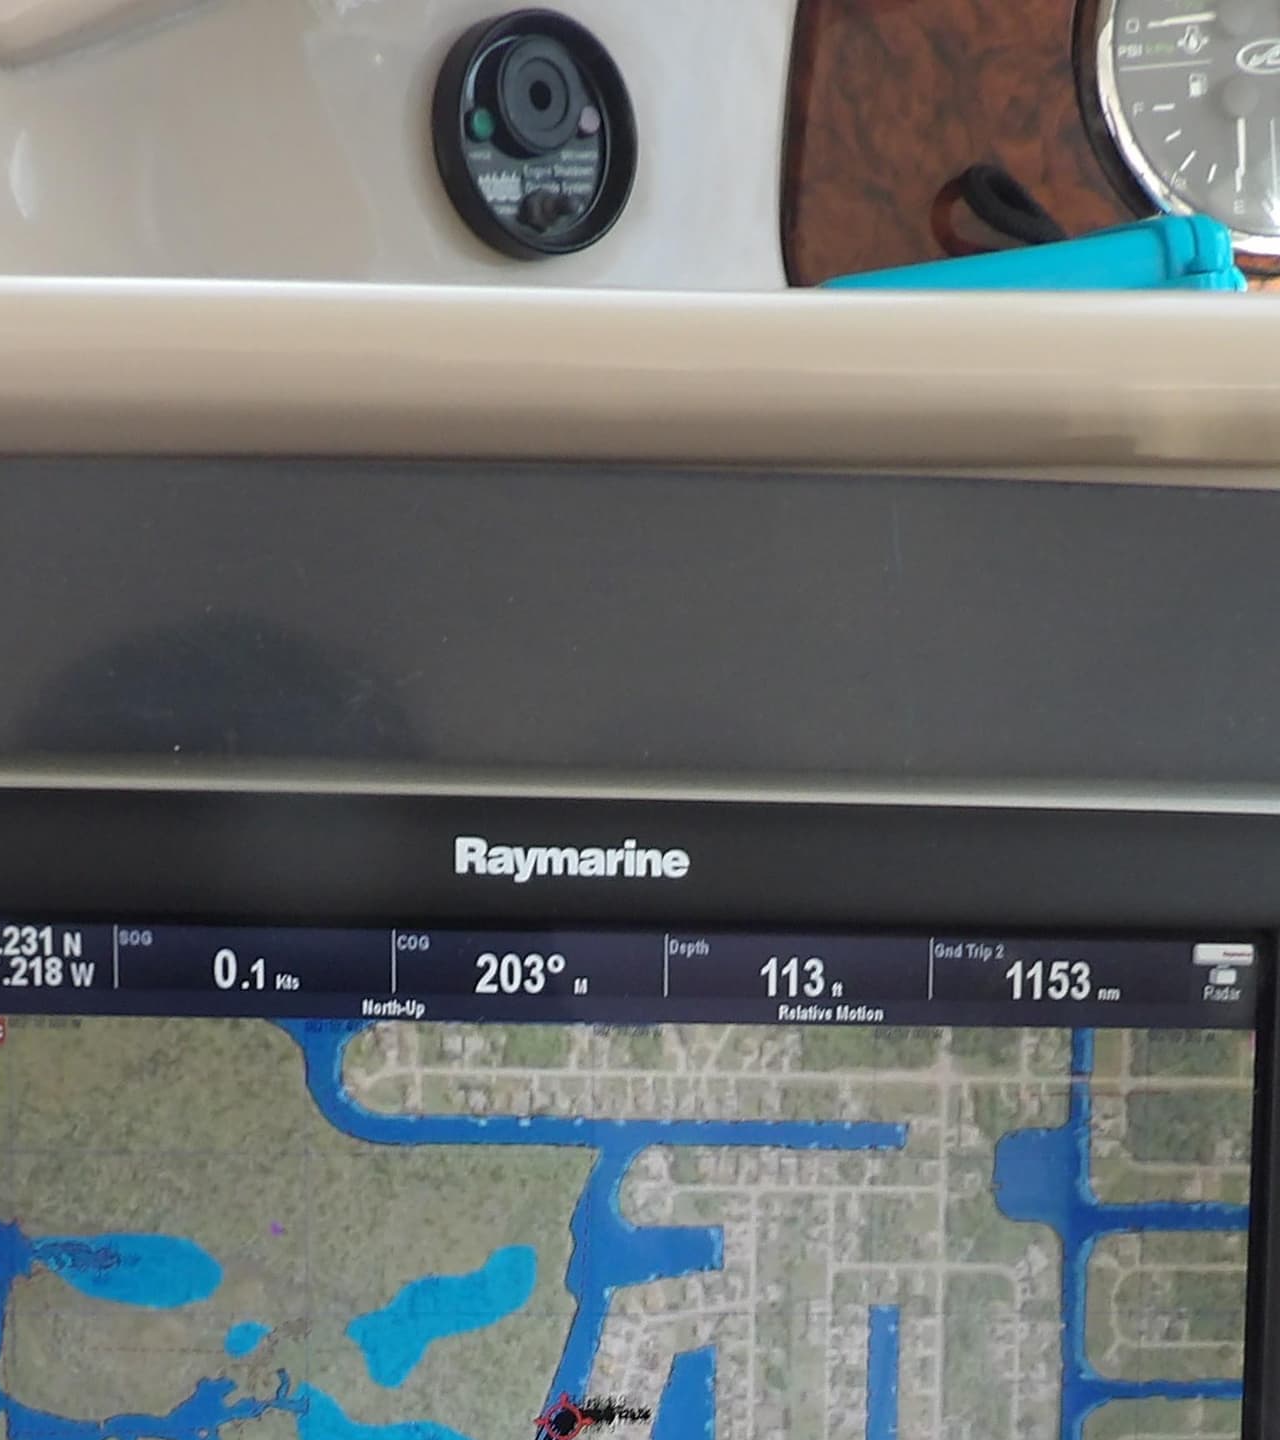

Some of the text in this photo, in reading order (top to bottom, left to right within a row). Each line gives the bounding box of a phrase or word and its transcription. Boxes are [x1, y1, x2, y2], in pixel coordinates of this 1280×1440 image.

[454, 836, 691, 883] Raymarine
[63, 932, 82, 957] N
[119, 930, 152, 946] SOG
[396, 934, 430, 951] COG
[669, 938, 710, 956] Depth
[934, 943, 1006, 963] Gnd Trip 2
[71, 962, 95, 988] W
[213, 948, 266, 990] 0.1
[475, 952, 589, 996] 203° M
[760, 956, 825, 998] 113
[1005, 960, 1121, 1001] 1153 nm
[1202, 984, 1242, 1001] Radar
[361, 998, 426, 1020] North-Up
[778, 1004, 884, 1022] Relative Motion
